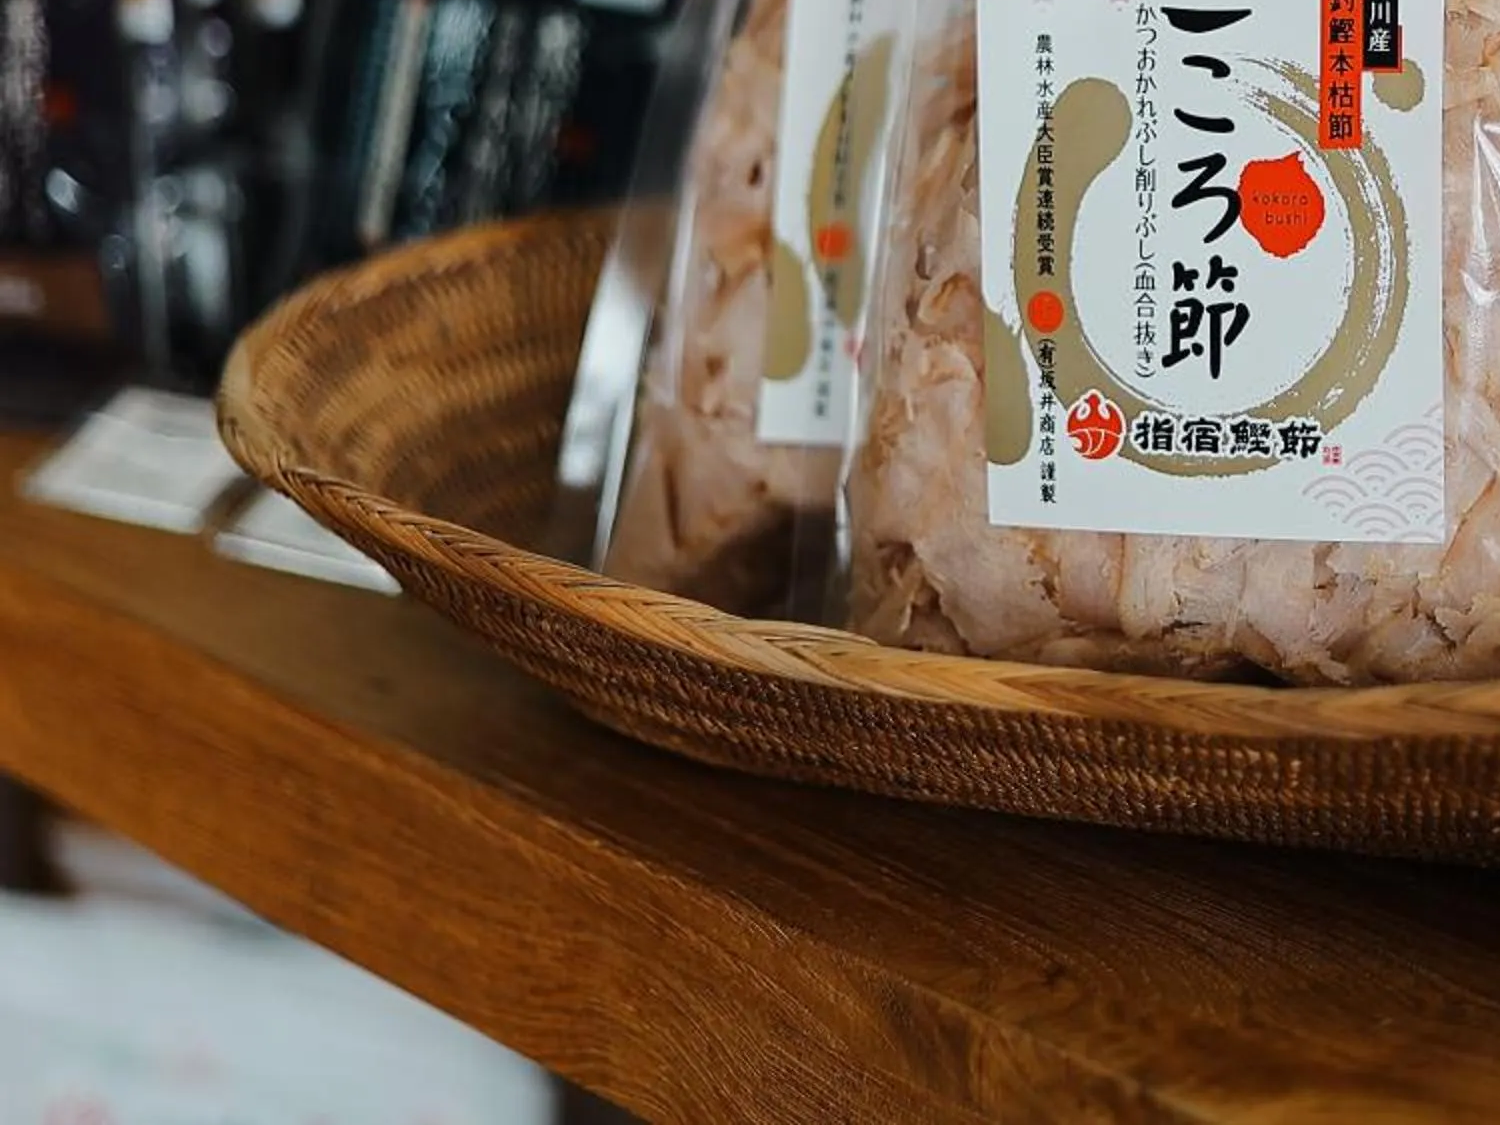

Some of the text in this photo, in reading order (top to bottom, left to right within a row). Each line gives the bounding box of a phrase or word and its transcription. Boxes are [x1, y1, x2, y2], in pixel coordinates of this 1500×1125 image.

[1035, 33, 1056, 278] 農林水産大臣賞連続受賞
[1252, 190, 1309, 206] kokoro
[1265, 211, 1308, 225] bushi
[1133, 413, 1322, 459] 指宿鰹節
